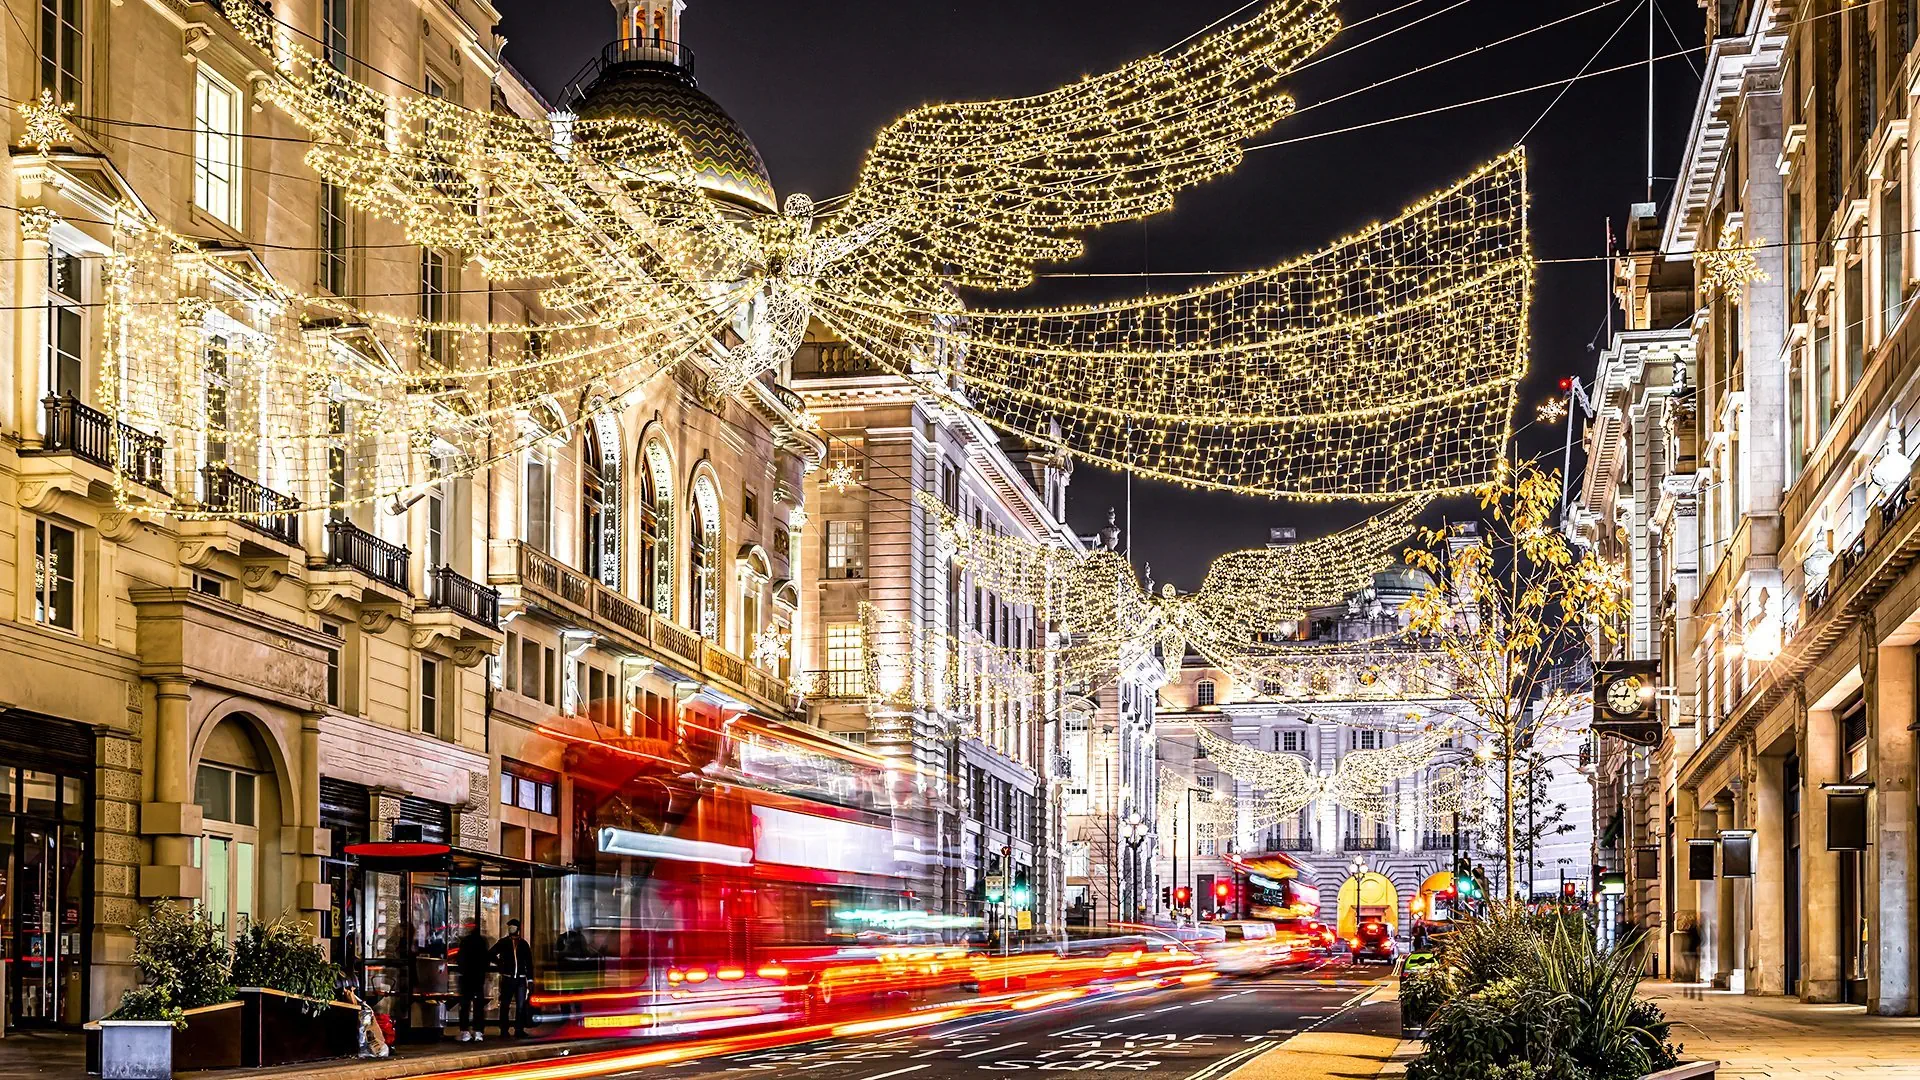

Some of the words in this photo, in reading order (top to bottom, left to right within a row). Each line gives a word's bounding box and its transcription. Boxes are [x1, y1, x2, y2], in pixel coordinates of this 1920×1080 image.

[1061, 1032, 1279, 1042] SHAFT
[1060, 1041, 1214, 1049] AVE
[725, 1060, 862, 1071] ST
[977, 1060, 1162, 1071] SQR
